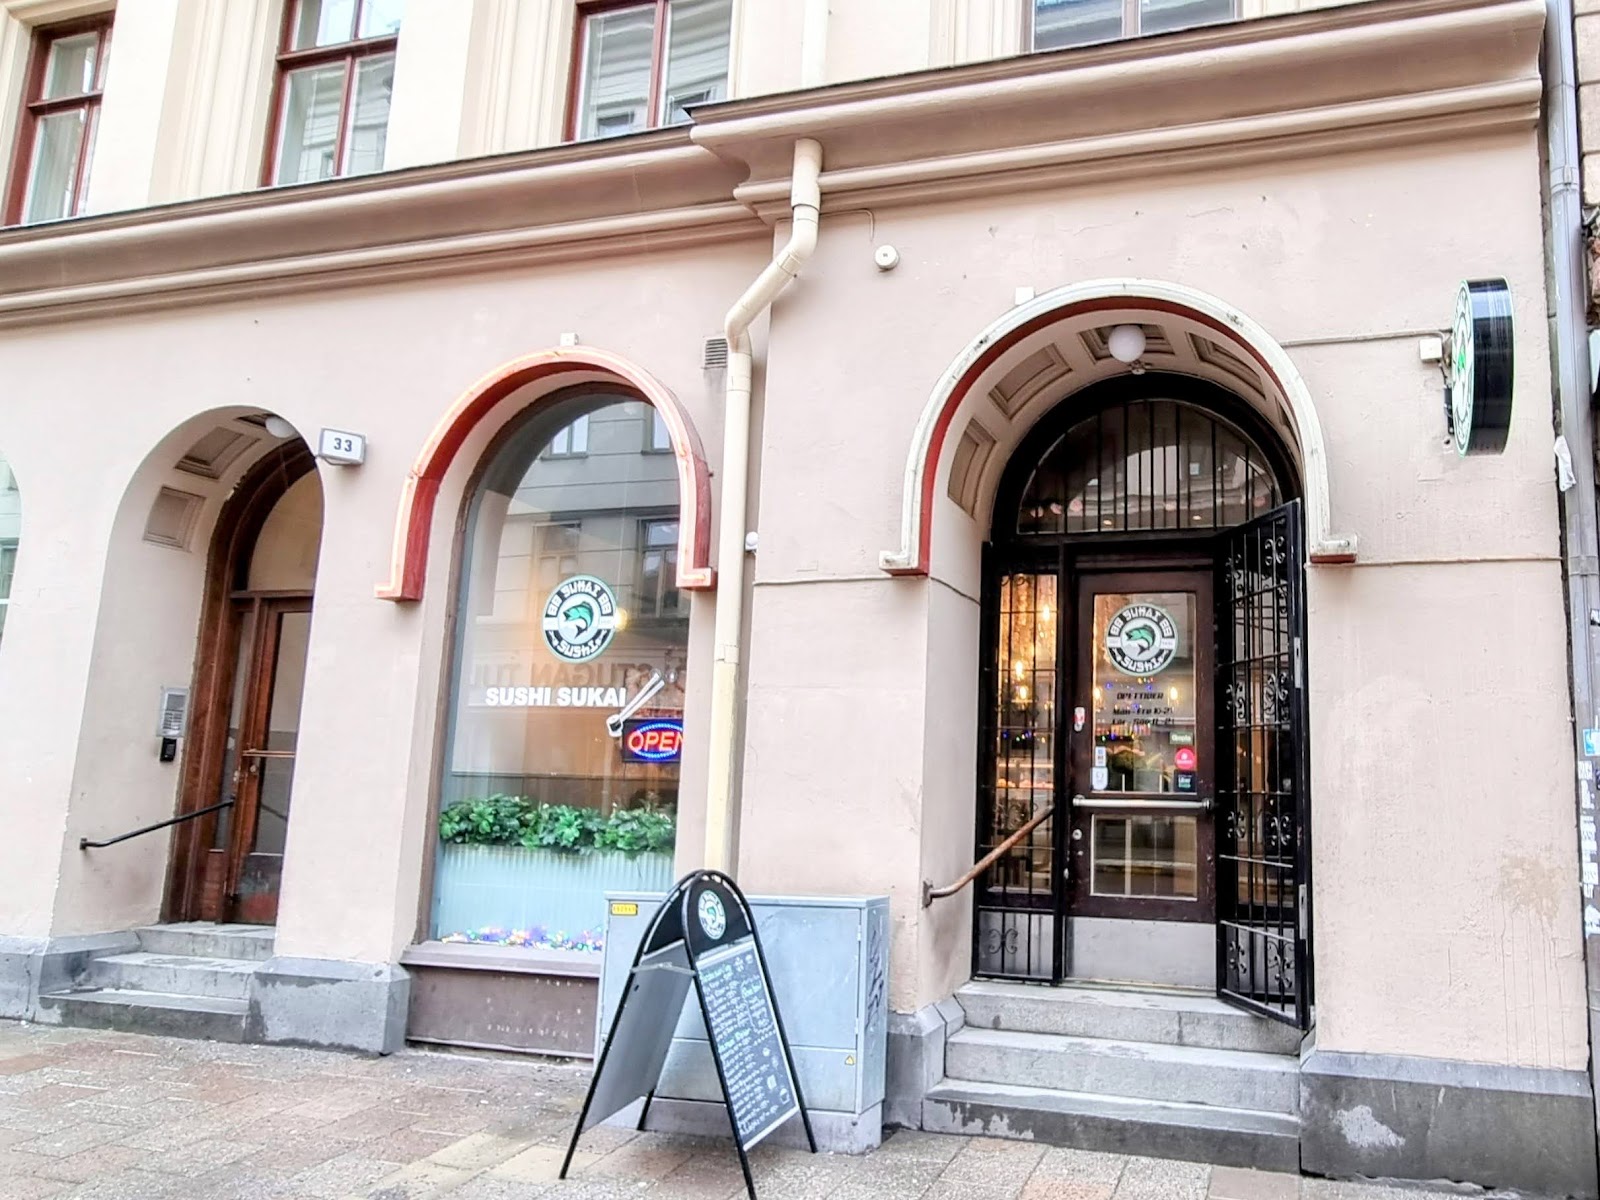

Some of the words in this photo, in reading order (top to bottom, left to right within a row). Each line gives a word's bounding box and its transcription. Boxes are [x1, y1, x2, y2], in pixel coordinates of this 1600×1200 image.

[333, 437, 353, 452] 33
[486, 687, 551, 706] SUSHI
[557, 687, 626, 707] SUKAI
[628, 731, 684, 751] OPEN
